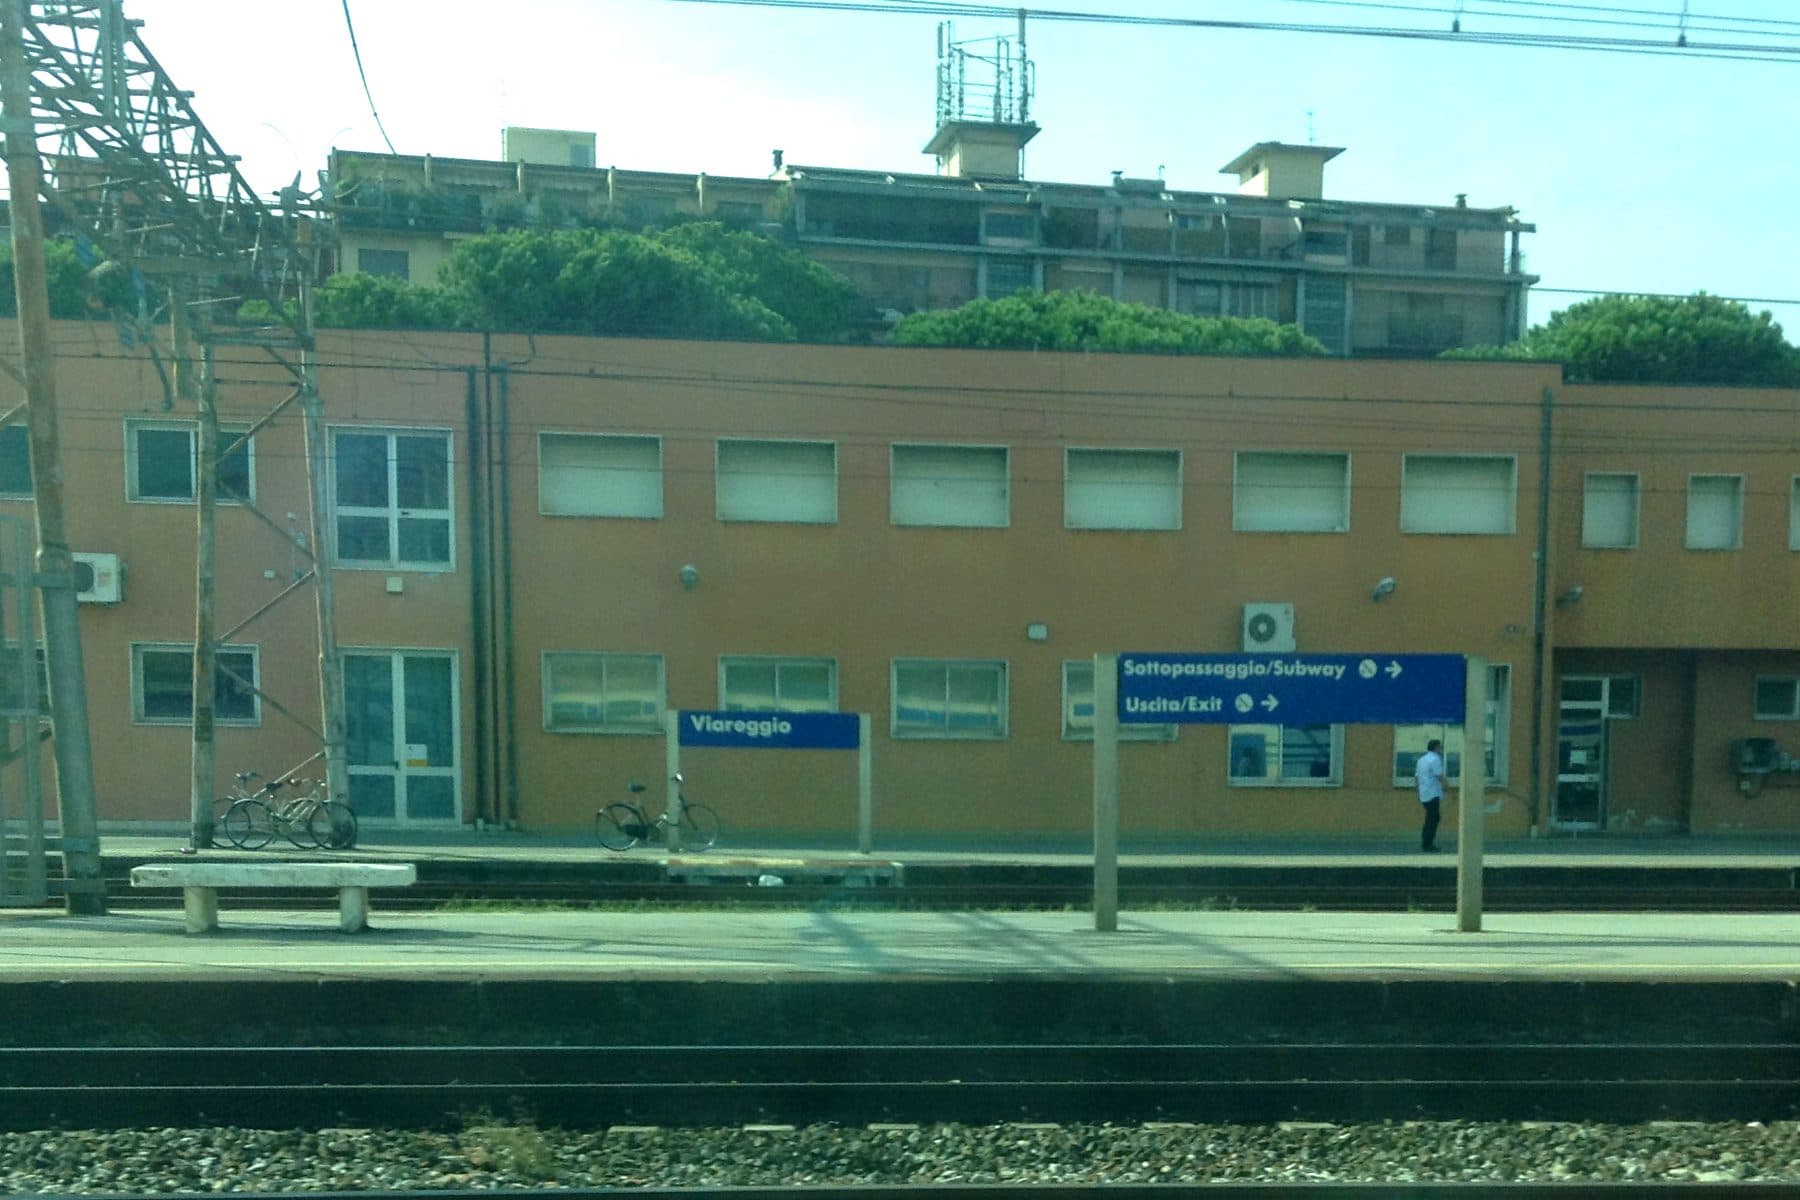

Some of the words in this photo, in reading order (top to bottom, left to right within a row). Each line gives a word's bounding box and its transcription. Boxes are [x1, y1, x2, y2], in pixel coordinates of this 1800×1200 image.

[1123, 659, 1346, 680] Sottopassaggio/Subway
[1126, 696, 1223, 713] Uscita/Exit
[690, 714, 792, 737] Viareggio
